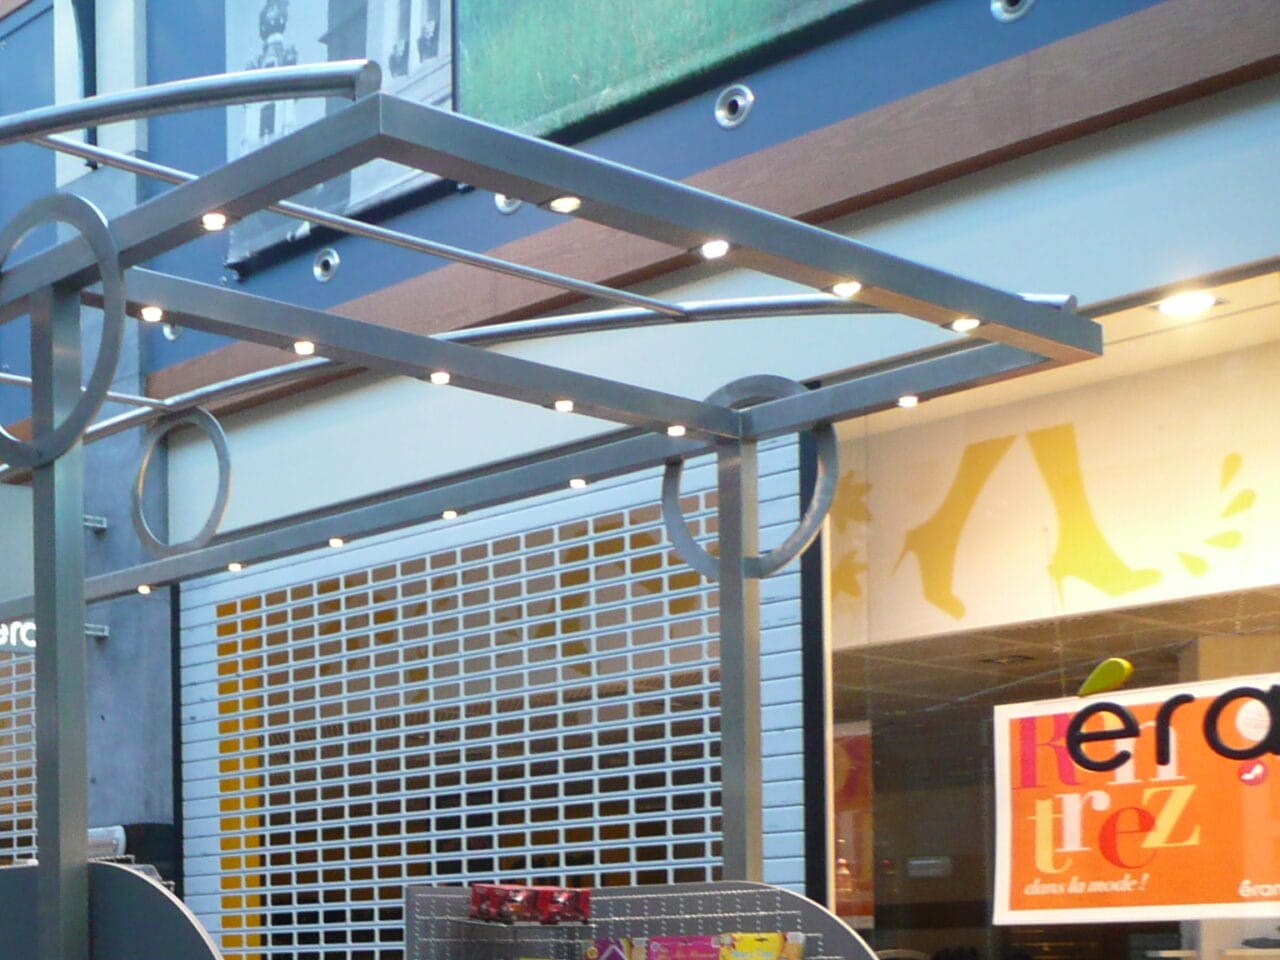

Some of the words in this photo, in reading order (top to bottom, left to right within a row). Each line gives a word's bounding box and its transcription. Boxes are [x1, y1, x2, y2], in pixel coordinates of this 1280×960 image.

[1026, 785, 1201, 875] trez
[1024, 877, 1064, 896] dans
[1067, 875, 1087, 895] la
